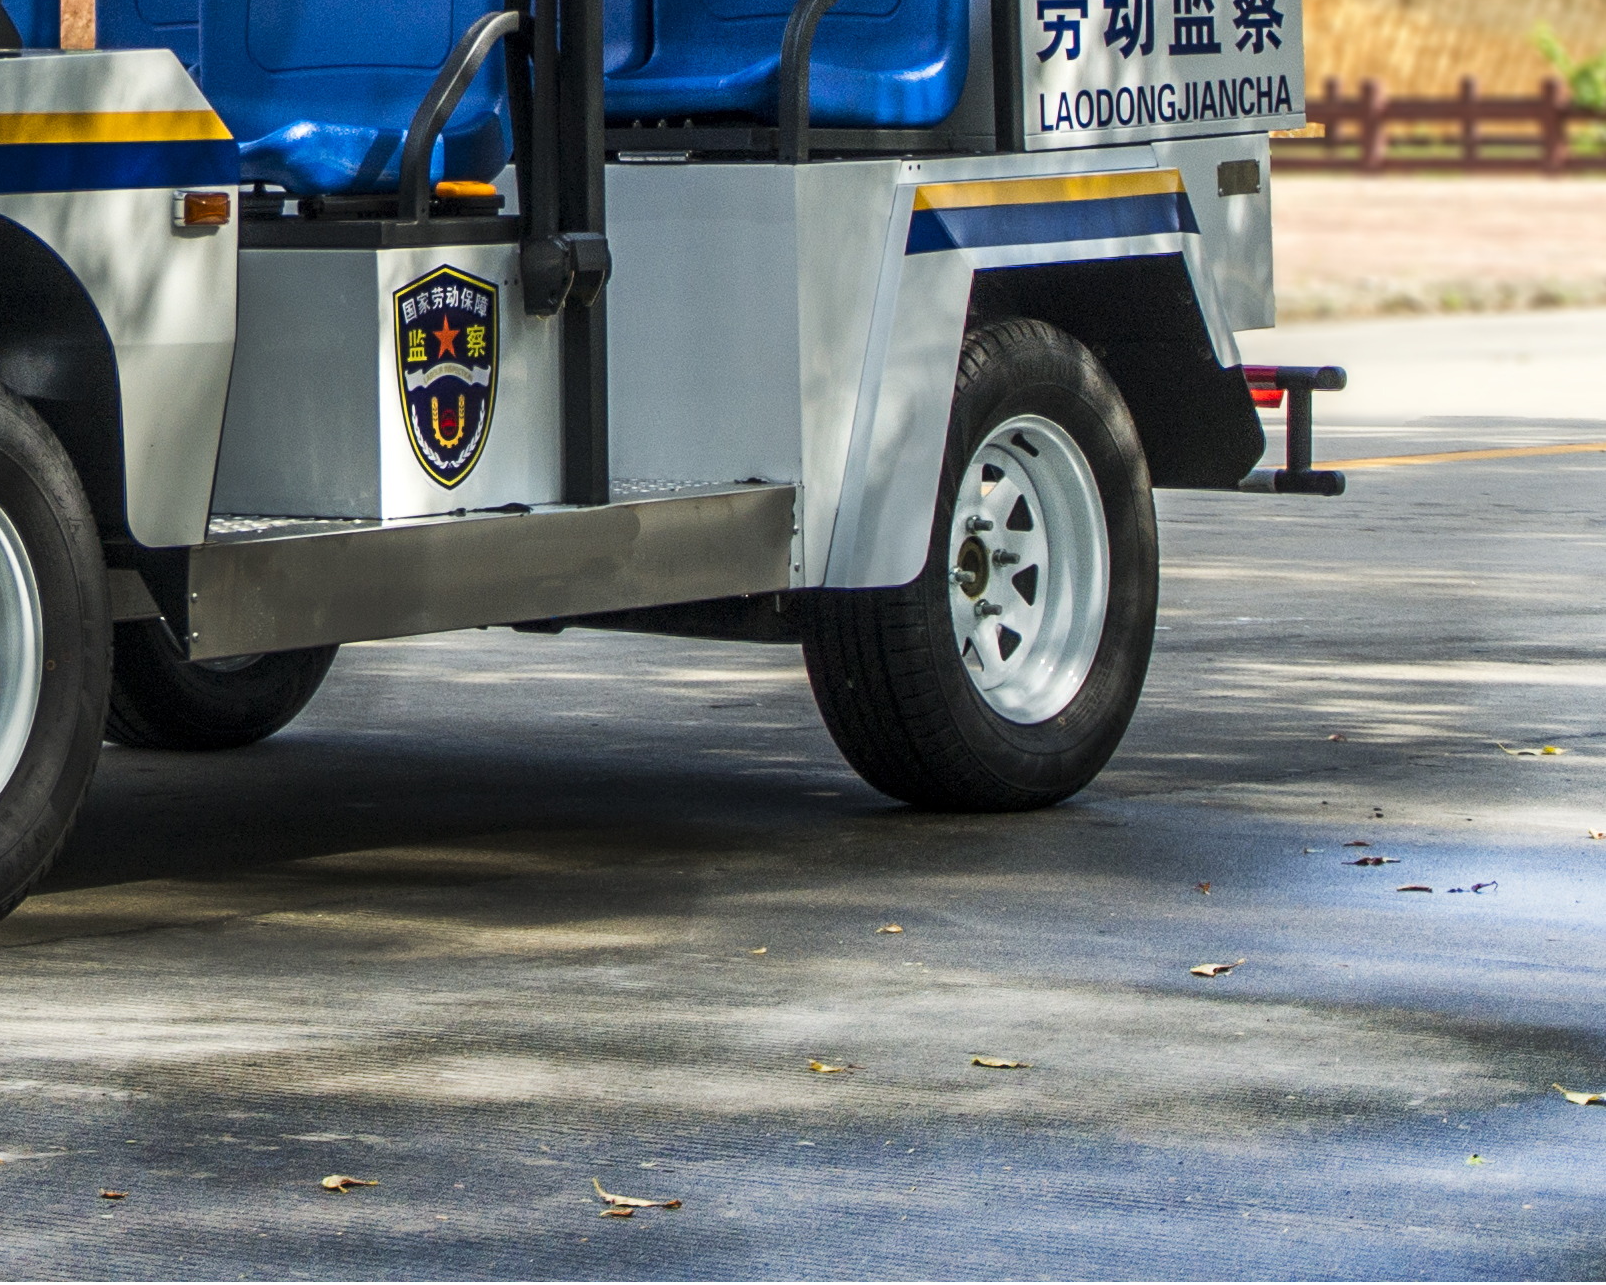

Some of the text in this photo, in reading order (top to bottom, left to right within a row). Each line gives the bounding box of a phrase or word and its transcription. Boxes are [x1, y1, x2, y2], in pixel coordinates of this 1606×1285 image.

[1039, 74, 1293, 132] LAODONGJIANCHA
[402, 285, 490, 324] 国家劳动保障
